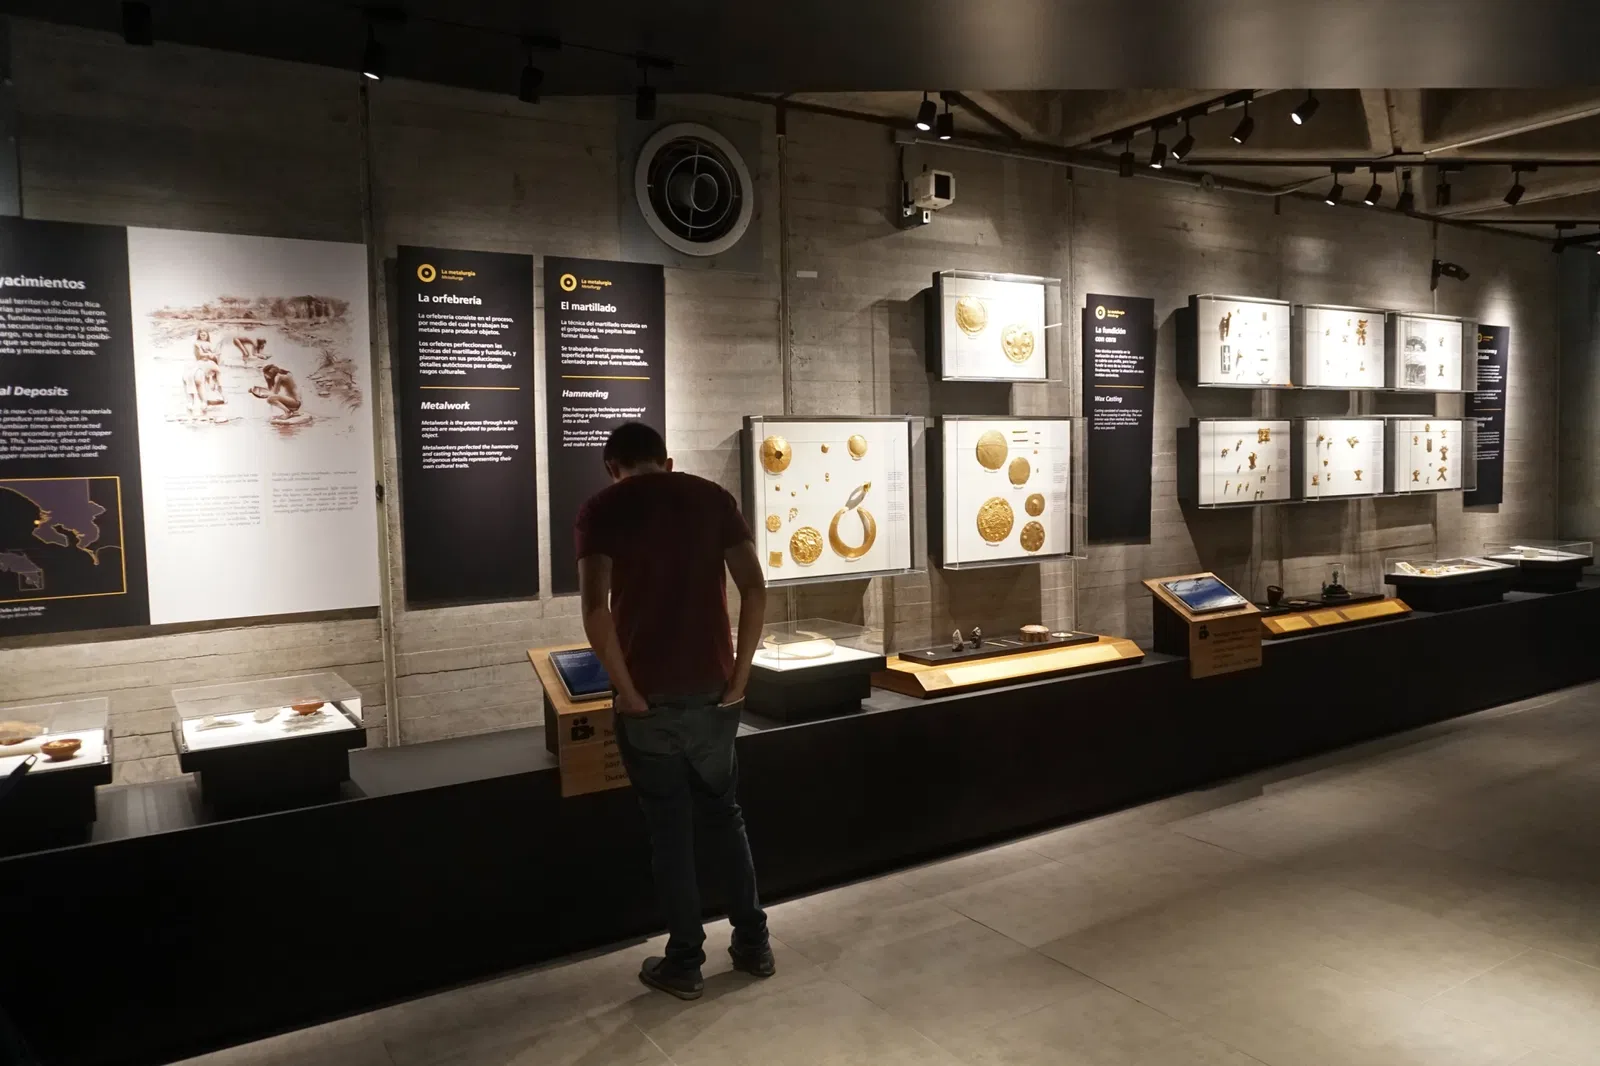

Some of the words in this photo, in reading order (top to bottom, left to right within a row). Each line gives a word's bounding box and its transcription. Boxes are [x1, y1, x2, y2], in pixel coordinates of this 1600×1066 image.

[418, 294, 430, 302] La
[432, 294, 482, 305] orfebrería
[561, 302, 569, 310] El
[572, 302, 617, 313] martillado
[477, 322, 499, 330] trabajan
[455, 328, 478, 336] producir
[1103, 327, 1126, 335] fundición
[454, 342, 494, 350] perfeccionaron
[14, 386, 69, 398] Deposits
[562, 390, 609, 399] Hammering
